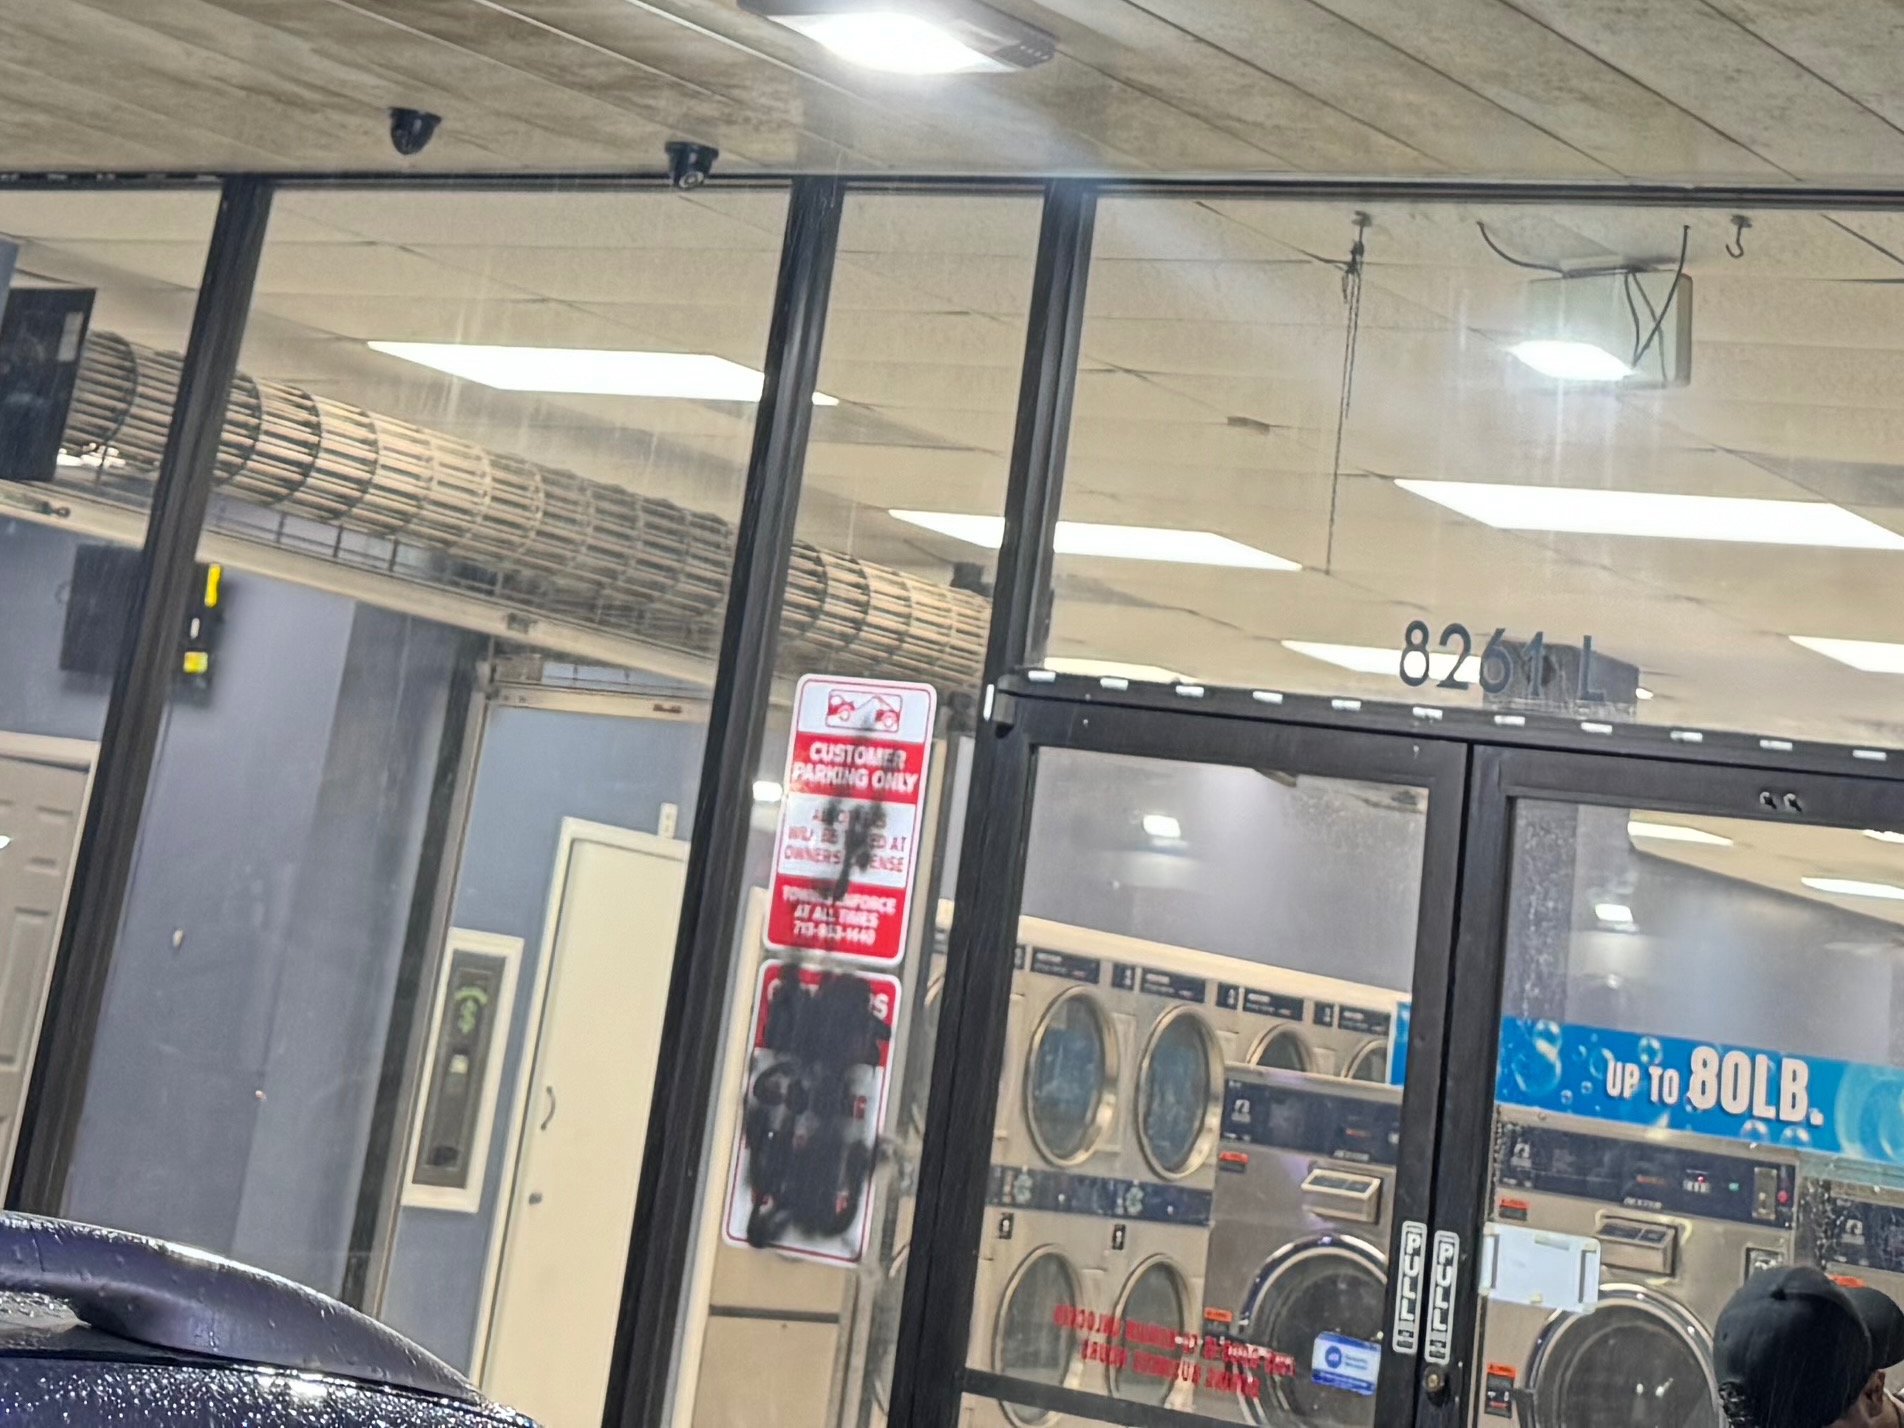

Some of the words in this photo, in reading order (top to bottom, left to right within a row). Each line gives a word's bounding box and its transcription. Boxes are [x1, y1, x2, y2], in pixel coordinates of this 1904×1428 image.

[1399, 619, 1544, 695] 8261
[791, 761, 870, 788] PARKING
[870, 769, 920, 794] ONLY
[809, 740, 908, 771] CUSTOMER
[834, 891, 898, 916] NFORCE
[1605, 1061, 1641, 1100] UP
[1648, 1064, 1681, 1105] TO
[1687, 1045, 1825, 1127] 80LB.
[1399, 1231, 1423, 1322] PULL
[1432, 1241, 1456, 1332] PULL
